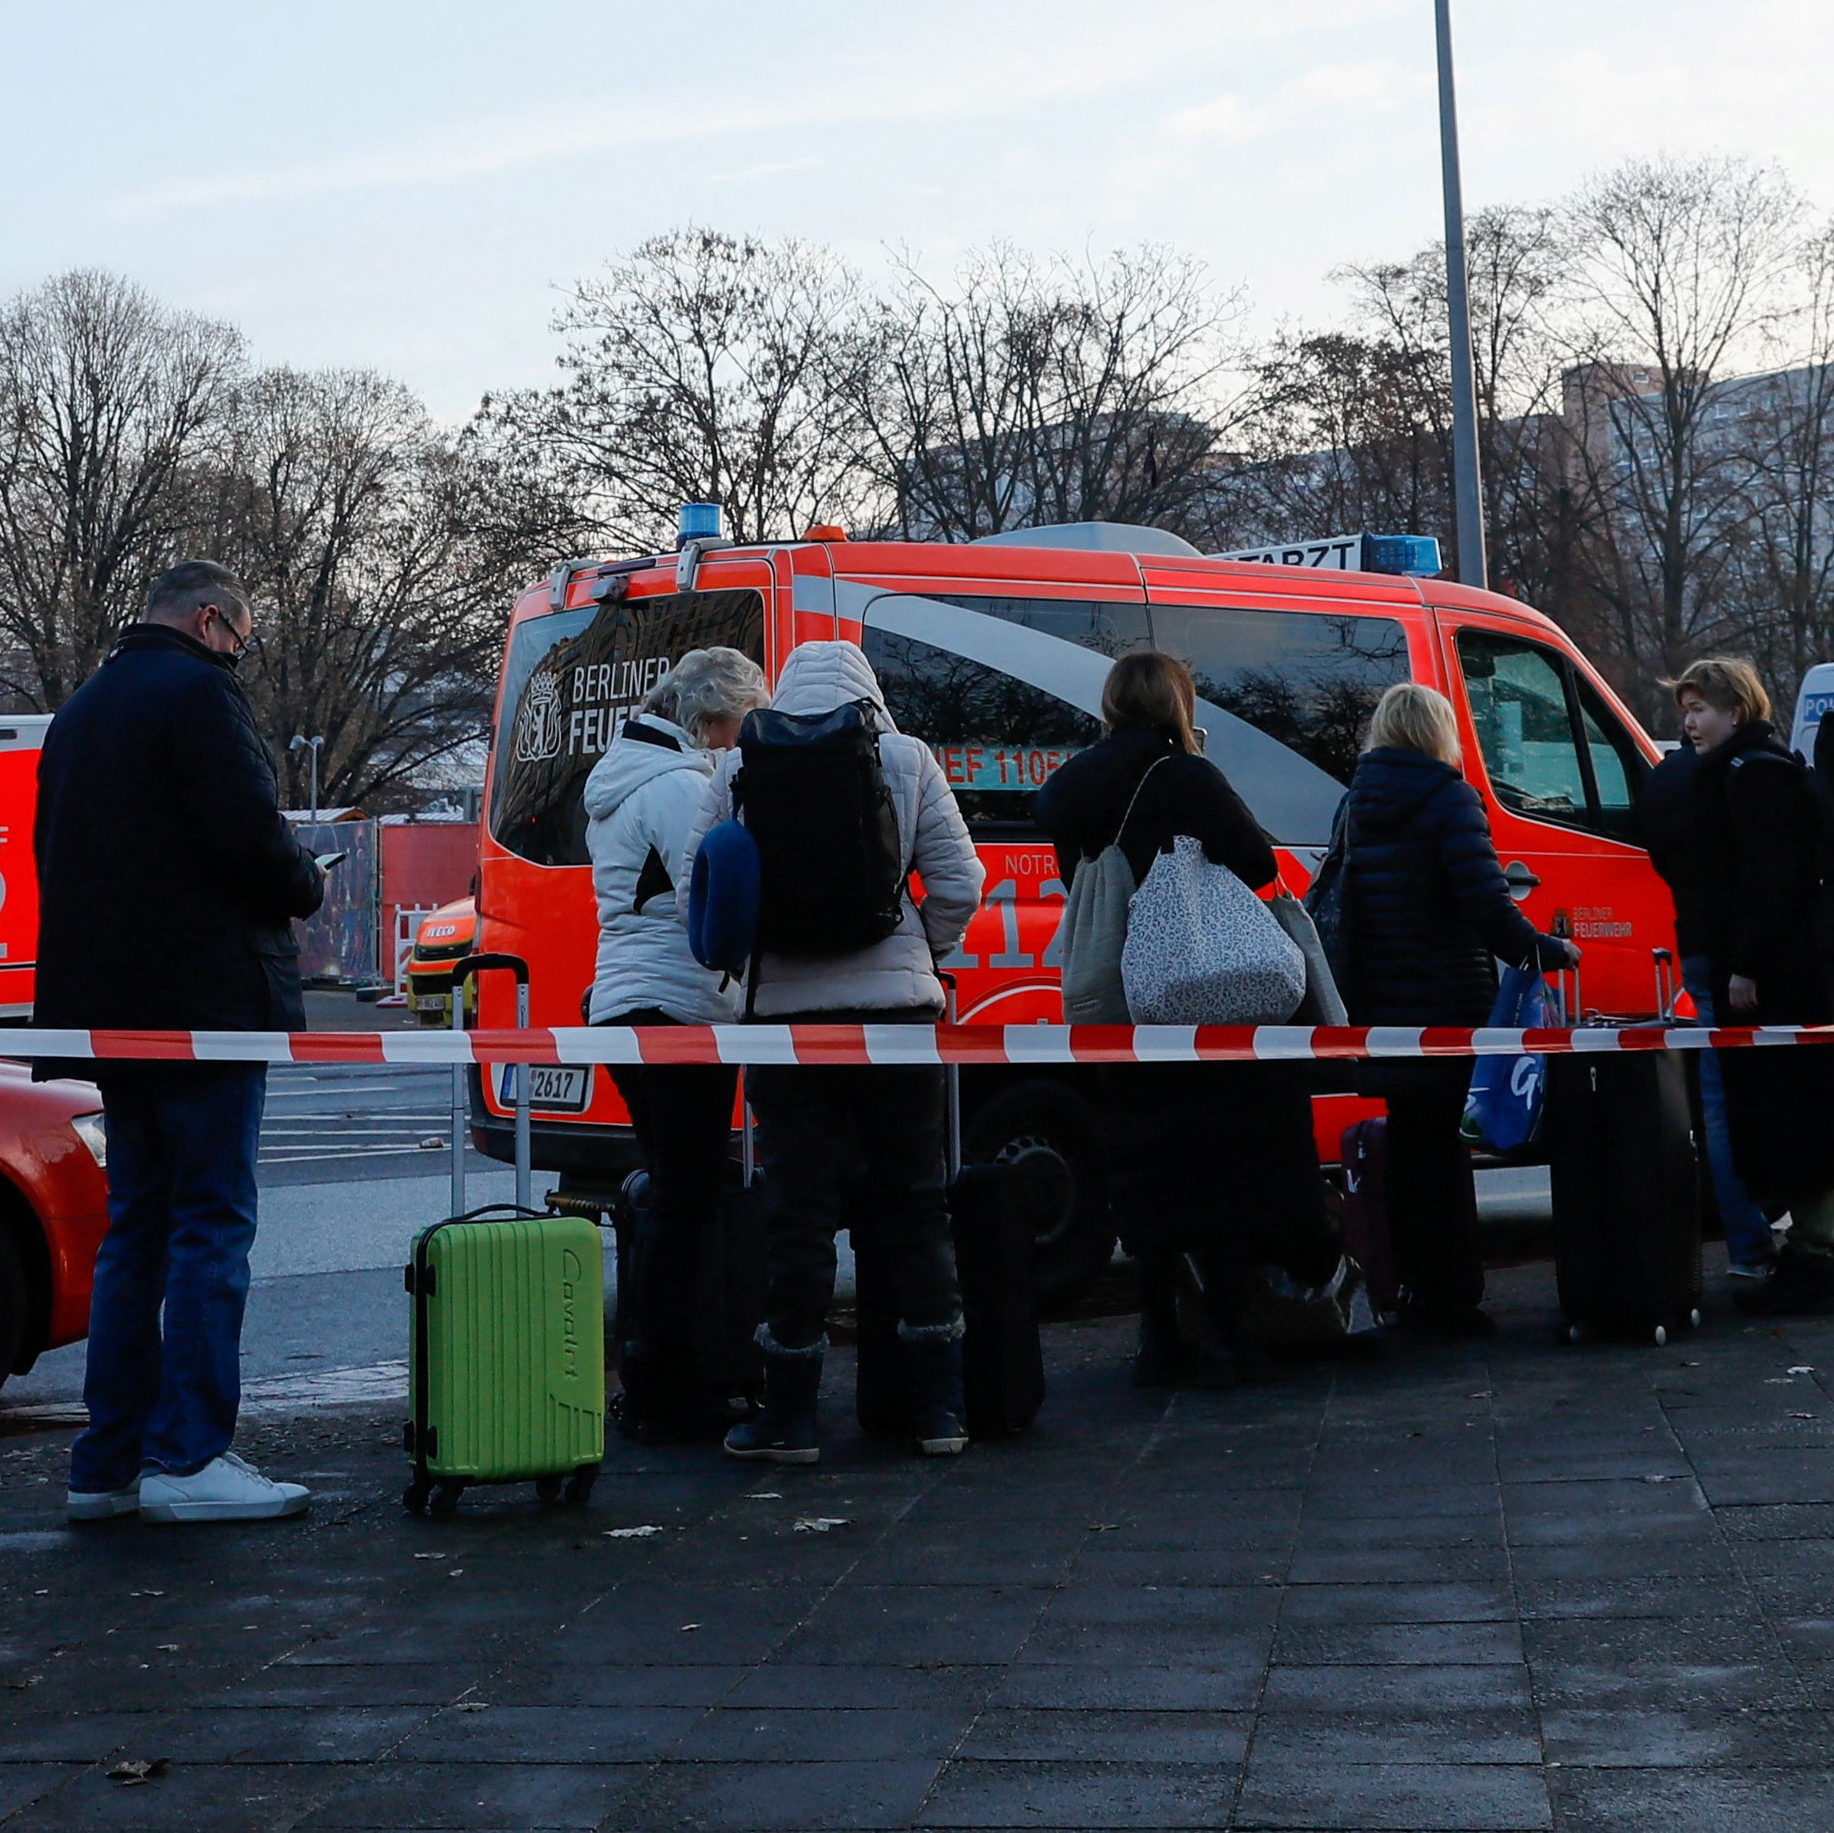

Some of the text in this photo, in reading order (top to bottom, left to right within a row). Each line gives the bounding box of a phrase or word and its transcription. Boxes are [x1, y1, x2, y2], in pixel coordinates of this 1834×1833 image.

[994, 749, 1073, 786] 1105
[1005, 854, 1060, 875] NOTR
[1573, 907, 1614, 921] BERLINER
[427, 924, 456, 938] IVECO
[1573, 922, 1633, 938] FEUERWEHR
[534, 1071, 574, 1098] 2617
